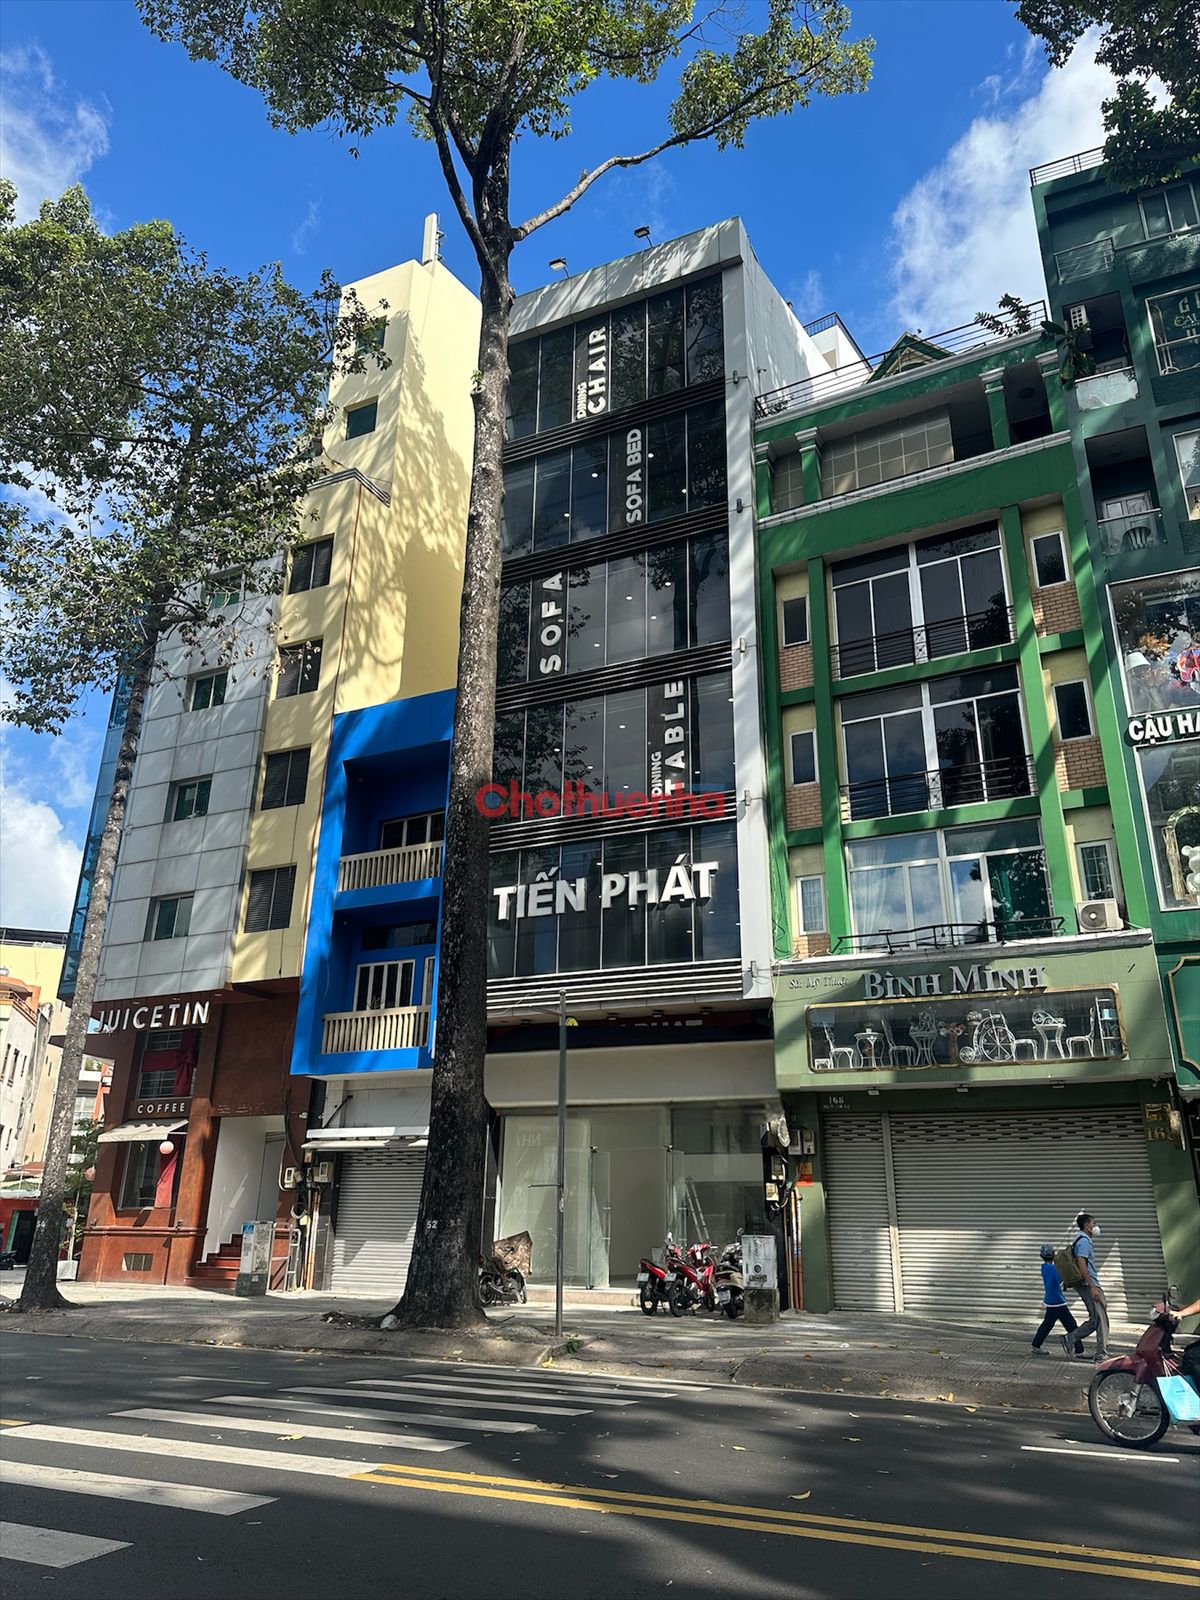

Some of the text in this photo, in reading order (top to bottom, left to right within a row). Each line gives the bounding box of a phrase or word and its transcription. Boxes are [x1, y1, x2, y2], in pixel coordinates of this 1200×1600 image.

[587, 326, 607, 414] CHAIR
[576, 381, 588, 419] DINING
[626, 428, 643, 525] SOFA BED
[540, 572, 563, 675] SOFA
[664, 680, 686, 797] TABLE
[1128, 711, 1200, 745] CẬU H
[651, 751, 663, 797] DINING
[493, 853, 719, 921] TIẾN PHÁT
[863, 963, 1048, 1000] BÌNH MINH
[94, 1001, 210, 1033] JUICETIN
[137, 1102, 185, 1114] COFFEE
